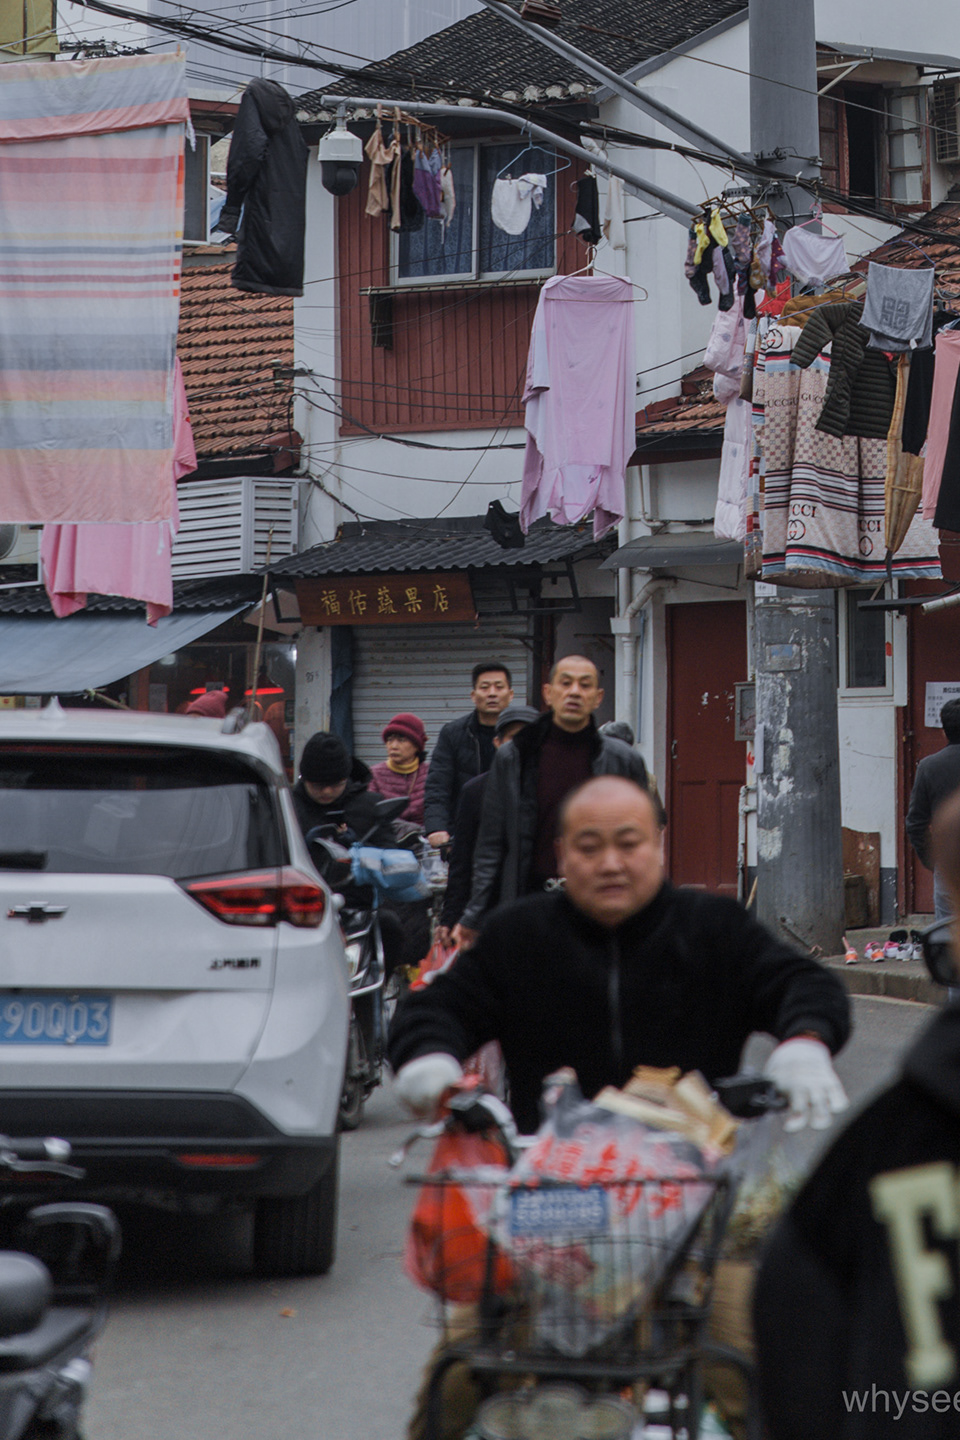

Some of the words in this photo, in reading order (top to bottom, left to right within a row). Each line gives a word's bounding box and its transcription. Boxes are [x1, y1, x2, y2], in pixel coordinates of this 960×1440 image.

[320, 584, 449, 616] 福佑蔬果店
